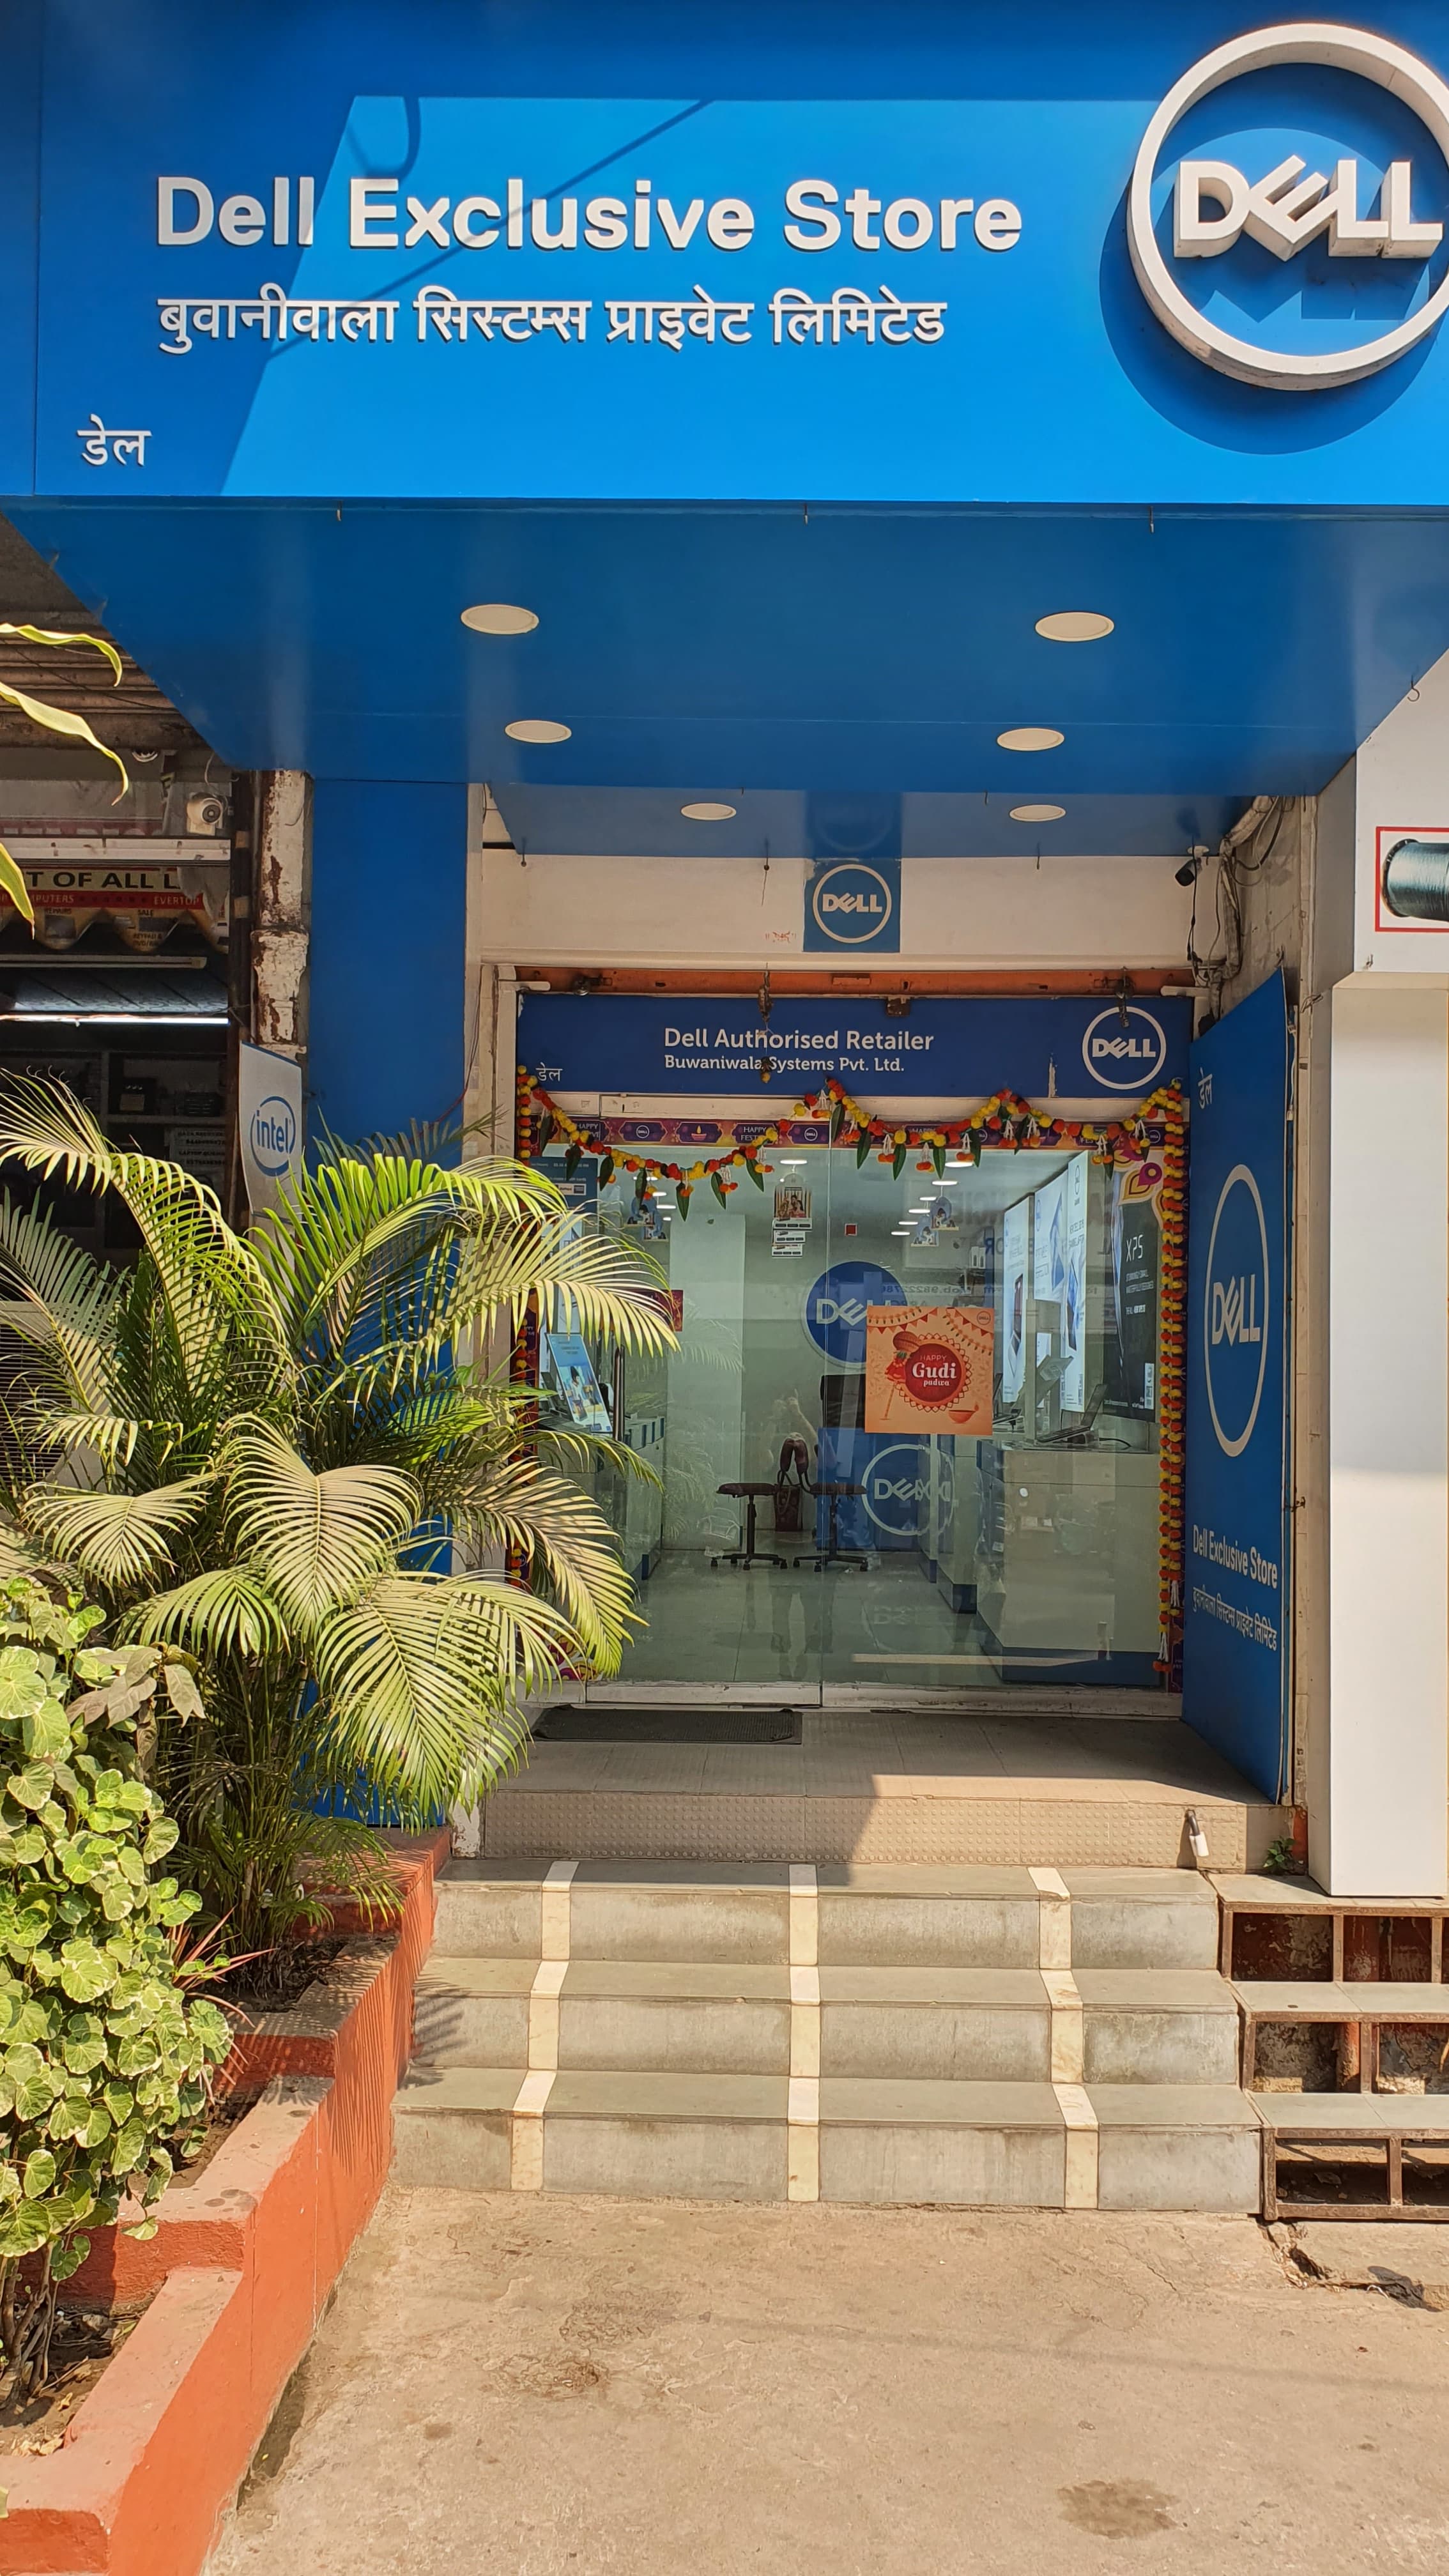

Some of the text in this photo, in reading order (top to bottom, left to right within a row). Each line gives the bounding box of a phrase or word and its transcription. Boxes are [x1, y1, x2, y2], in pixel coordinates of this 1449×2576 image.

[157, 176, 1022, 250] Dell Exclusive Store
[1174, 154, 1443, 261] DELL
[157, 282, 948, 354] बुवानीवाला सिस्टम्स प्राइवेट लिमिटेड
[77, 414, 152, 466] डेल
[53, 872, 92, 887] OF
[101, 872, 154, 889] ALL
[822, 893, 882, 914] DELL
[664, 1028, 934, 1050] Dell Authorised Retailer
[1092, 1038, 1156, 1059] DELL
[535, 1062, 563, 1082] डेल
[664, 1055, 904, 1073] Buwaniwala Systems Pvt. Ltd.
[257, 1110, 289, 1154] intel
[1212, 1274, 1261, 1347] DELL
[912, 1362, 957, 1379] Gudi
[1193, 1524, 1277, 1589] Dell Exclusive Store
